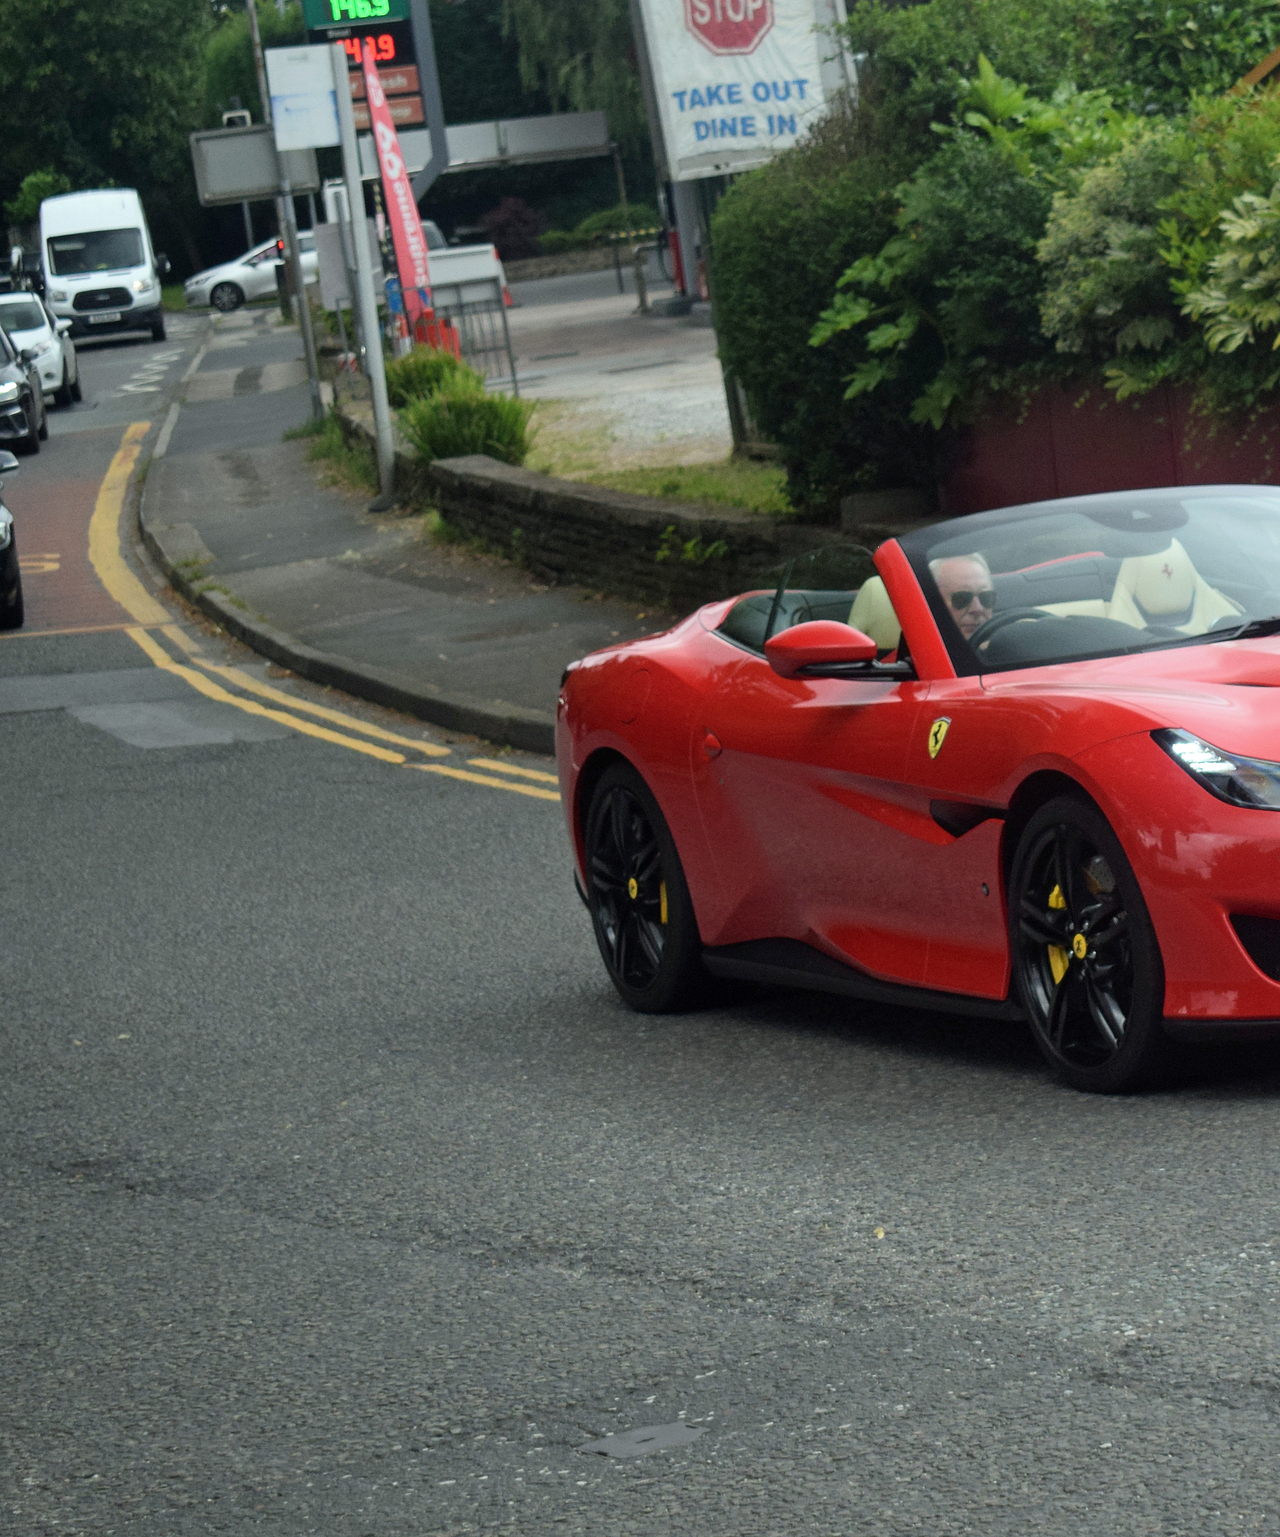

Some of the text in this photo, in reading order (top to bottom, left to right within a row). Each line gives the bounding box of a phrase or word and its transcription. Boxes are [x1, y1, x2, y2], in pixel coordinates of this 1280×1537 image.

[693, 0, 763, 24] STOP
[672, 79, 809, 112] TAKE OUT
[693, 113, 797, 141] DINE IN
